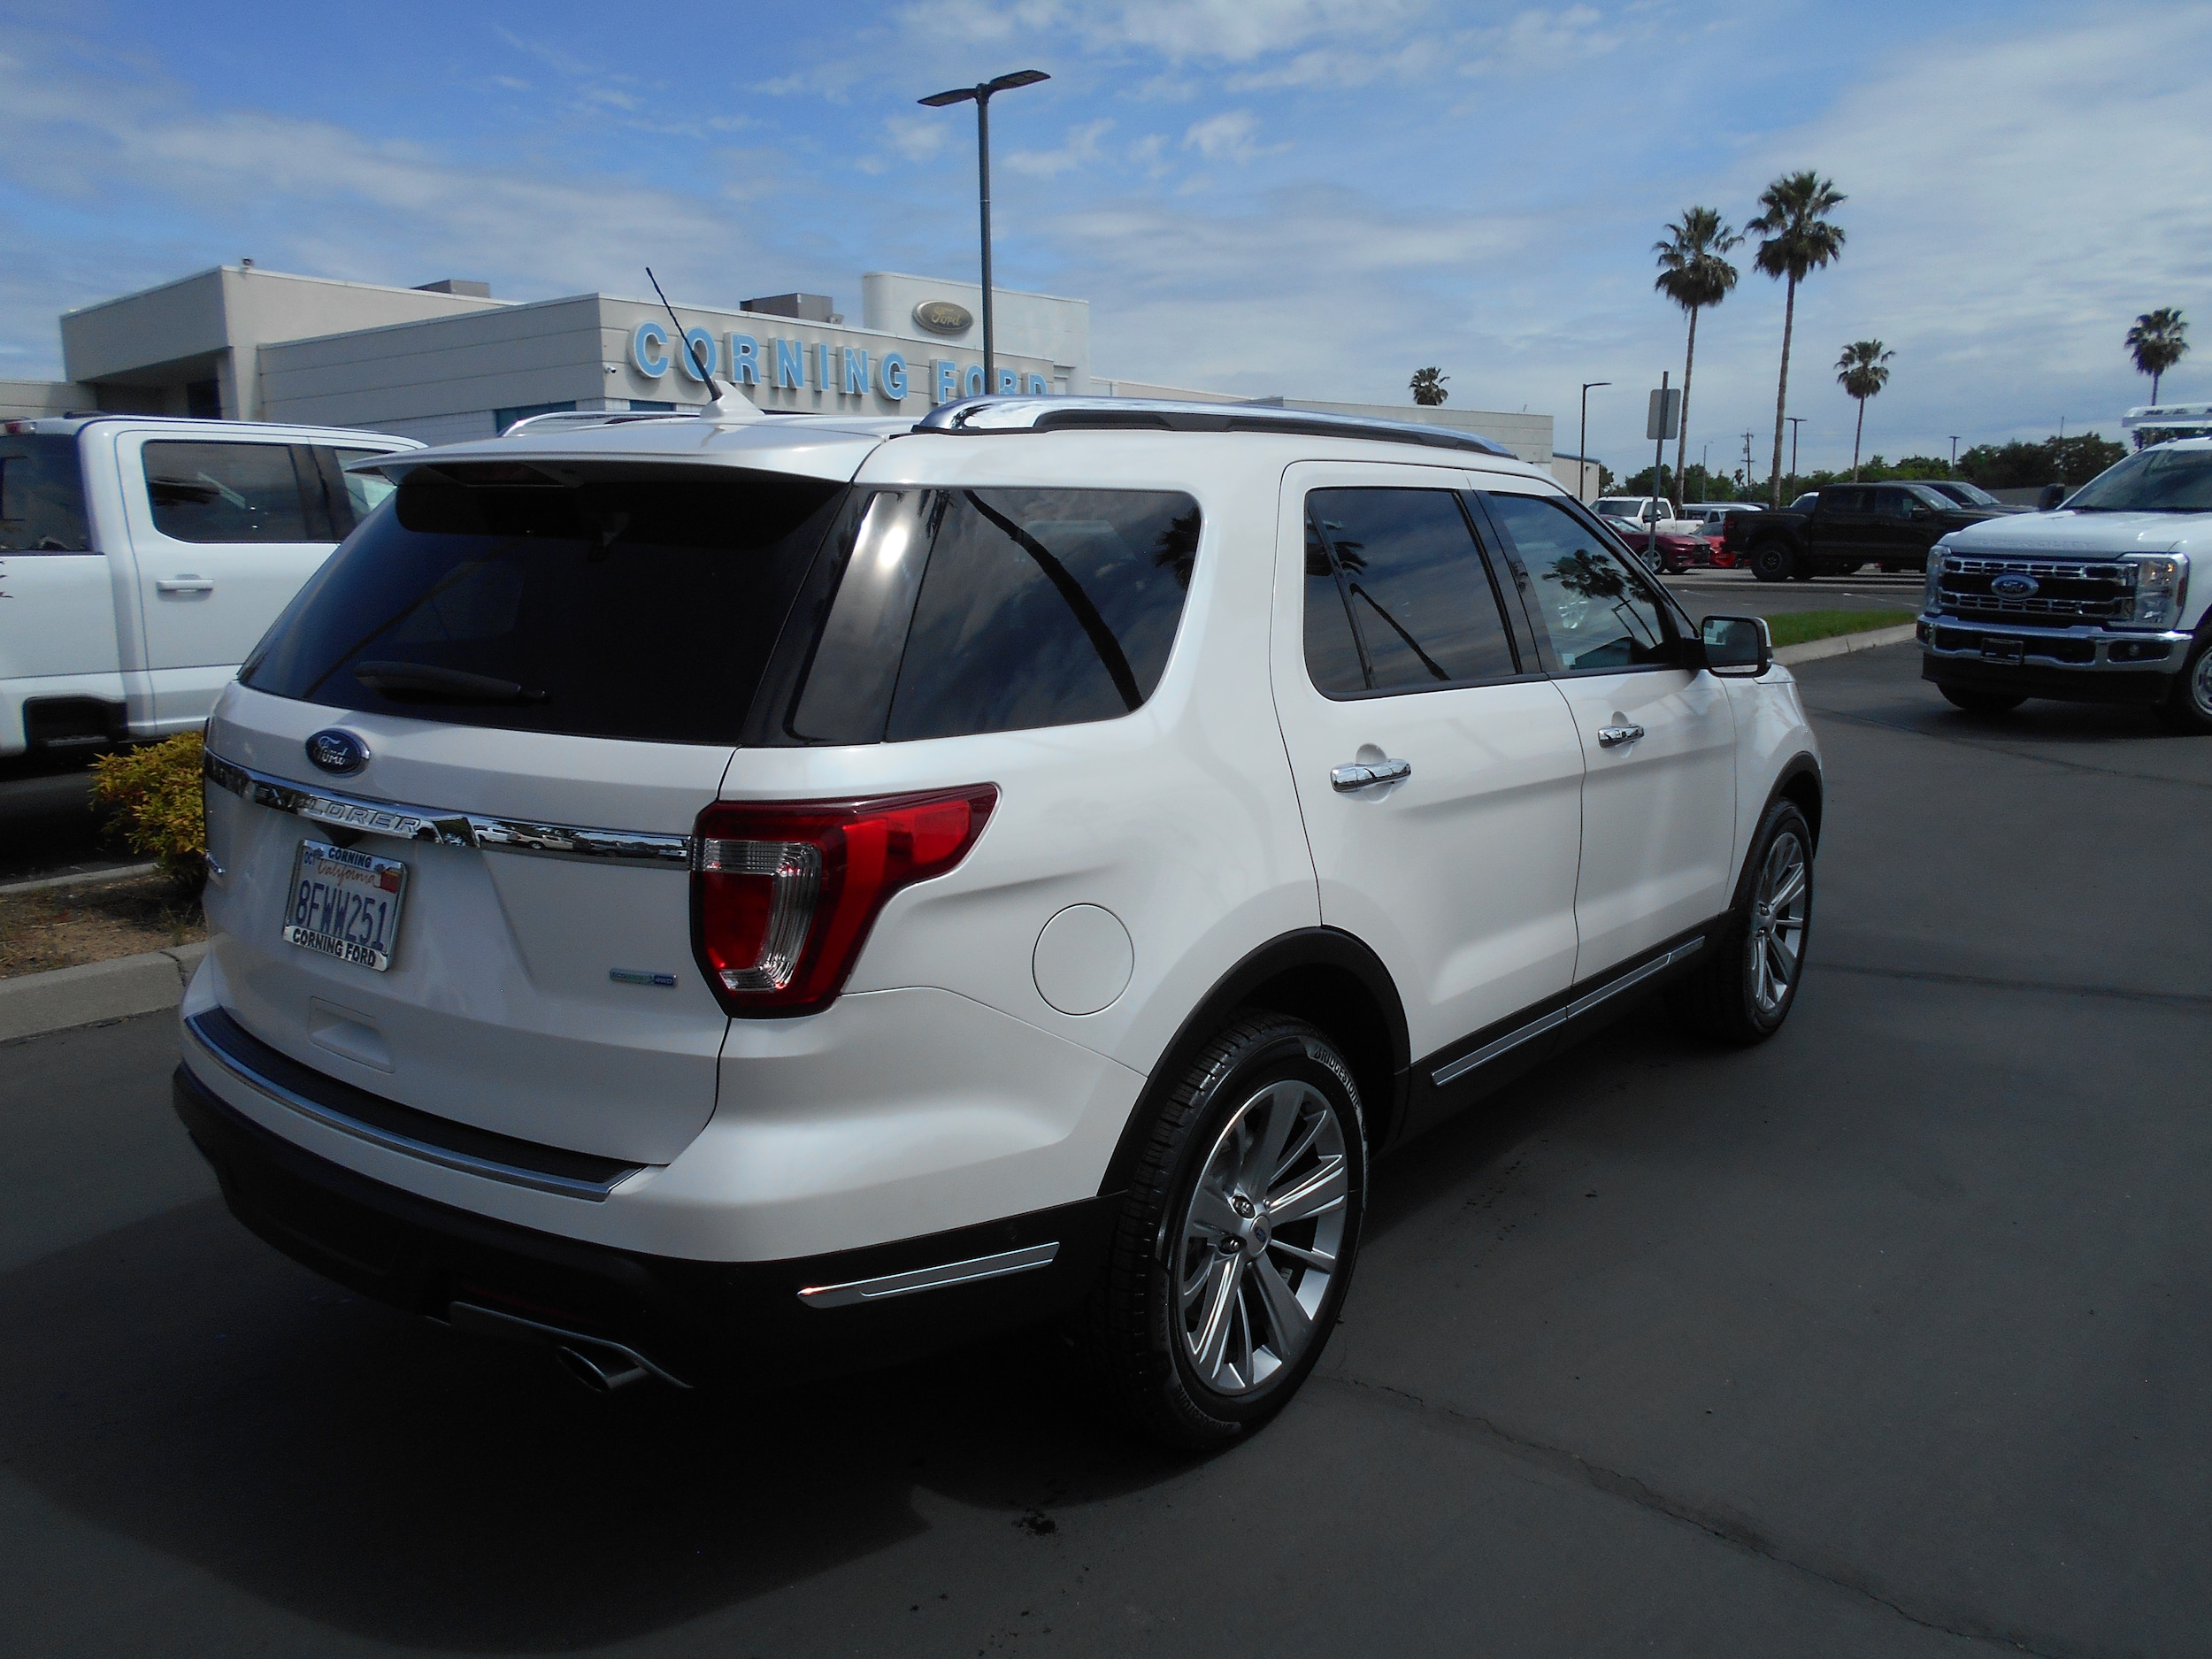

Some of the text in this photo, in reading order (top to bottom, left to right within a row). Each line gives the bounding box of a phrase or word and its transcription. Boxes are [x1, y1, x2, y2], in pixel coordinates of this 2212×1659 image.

[931, 307, 962, 326] Ford
[630, 320, 1048, 403] CORNING FORD
[313, 735, 349, 766] Ford
[317, 859, 375, 886] California
[328, 847, 373, 868] CORNING
[296, 879, 388, 951] 8FWW251
[293, 928, 376, 967] CORNING FORD
